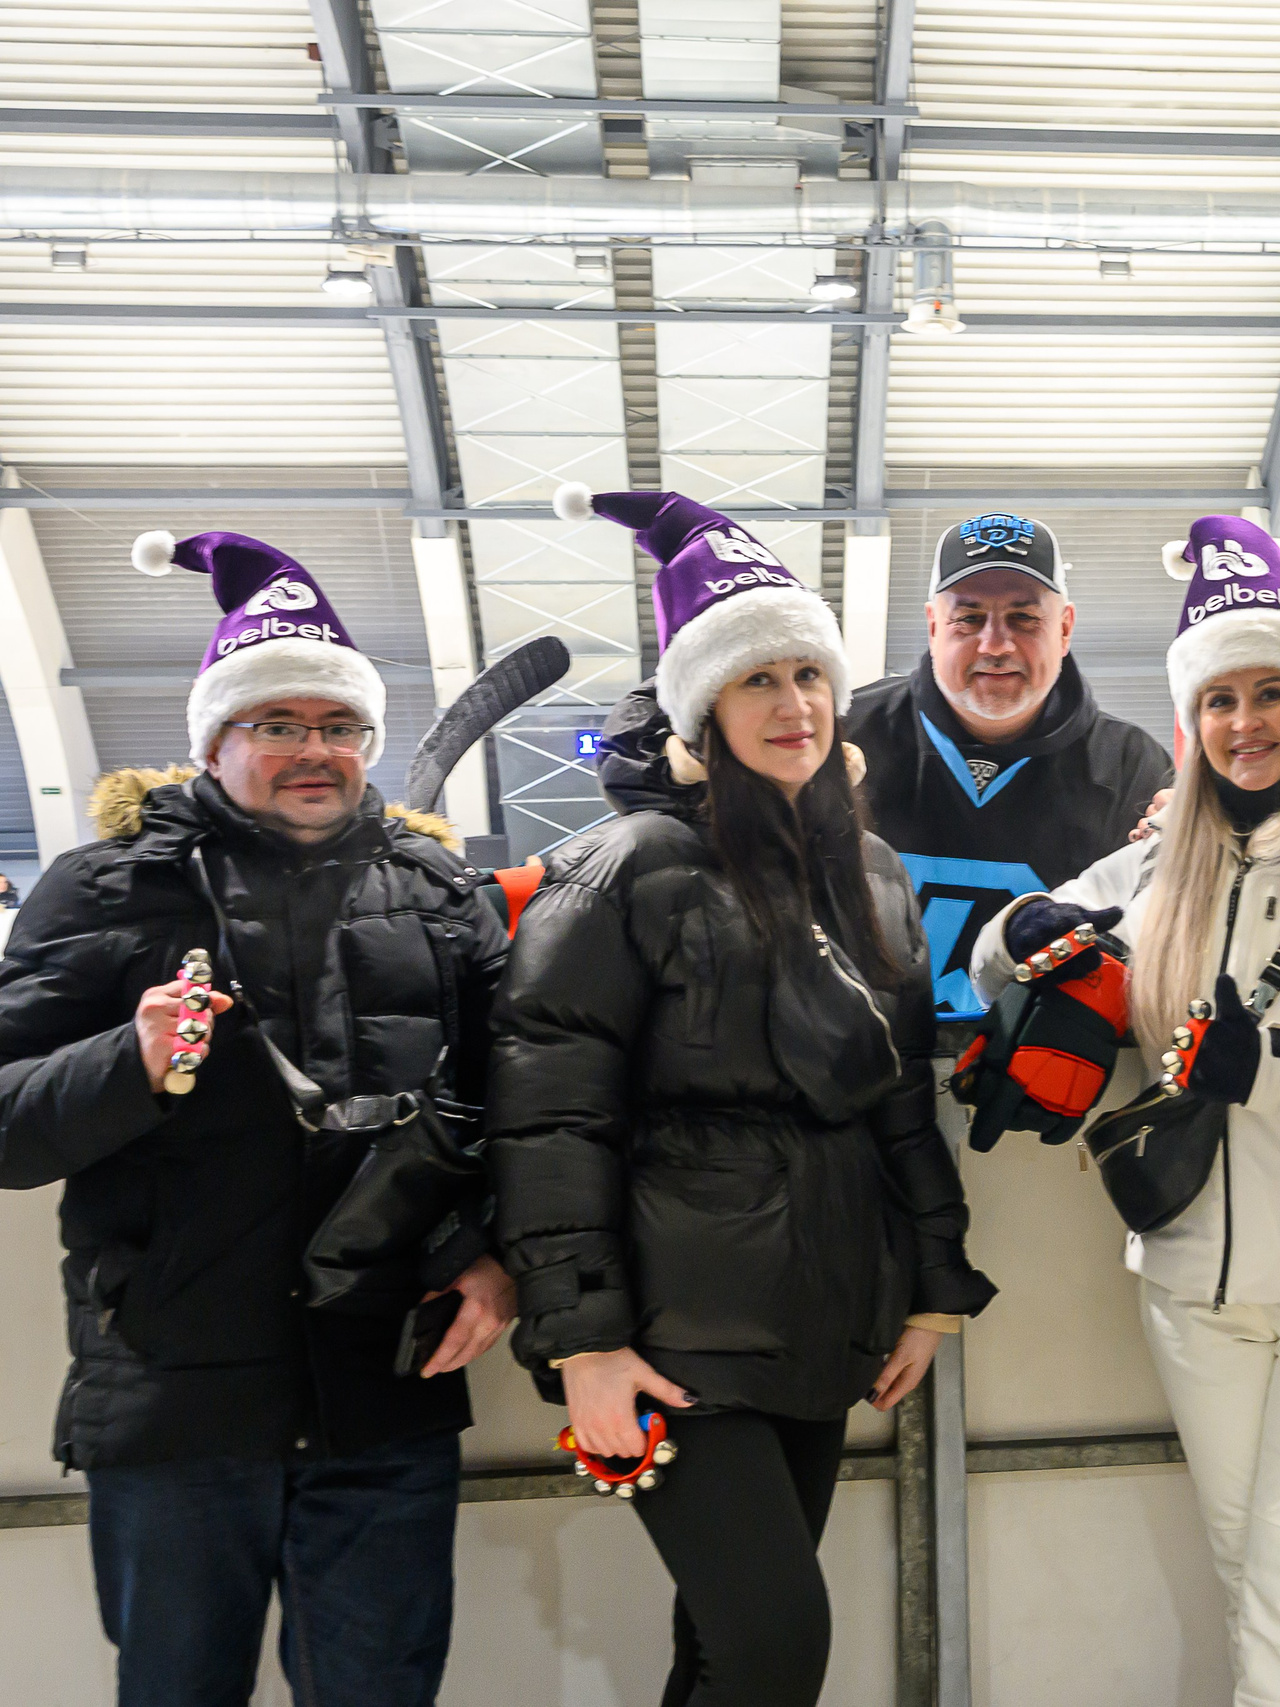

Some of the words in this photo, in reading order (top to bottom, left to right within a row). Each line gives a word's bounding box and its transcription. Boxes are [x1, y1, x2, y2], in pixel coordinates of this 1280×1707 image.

[704, 566, 803, 594] belb
[217, 617, 340, 655] belbet
[579, 734, 602, 753] 1
